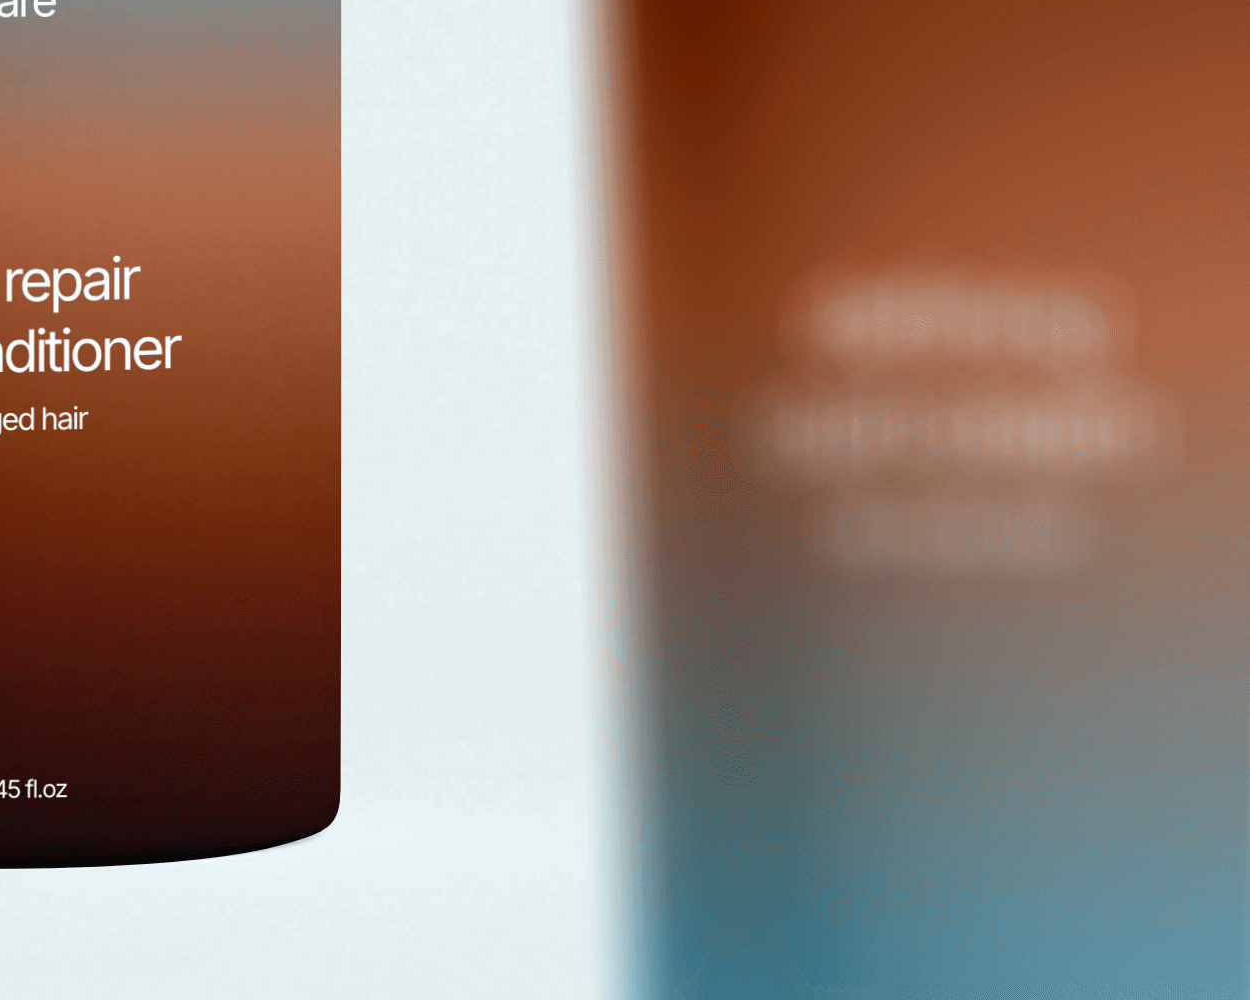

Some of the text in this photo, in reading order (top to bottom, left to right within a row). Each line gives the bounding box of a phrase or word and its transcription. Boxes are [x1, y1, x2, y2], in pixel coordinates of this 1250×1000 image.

[6, 255, 142, 314] repair
[42, 405, 90, 431] hair
[24, 778, 68, 799] fl.oz
